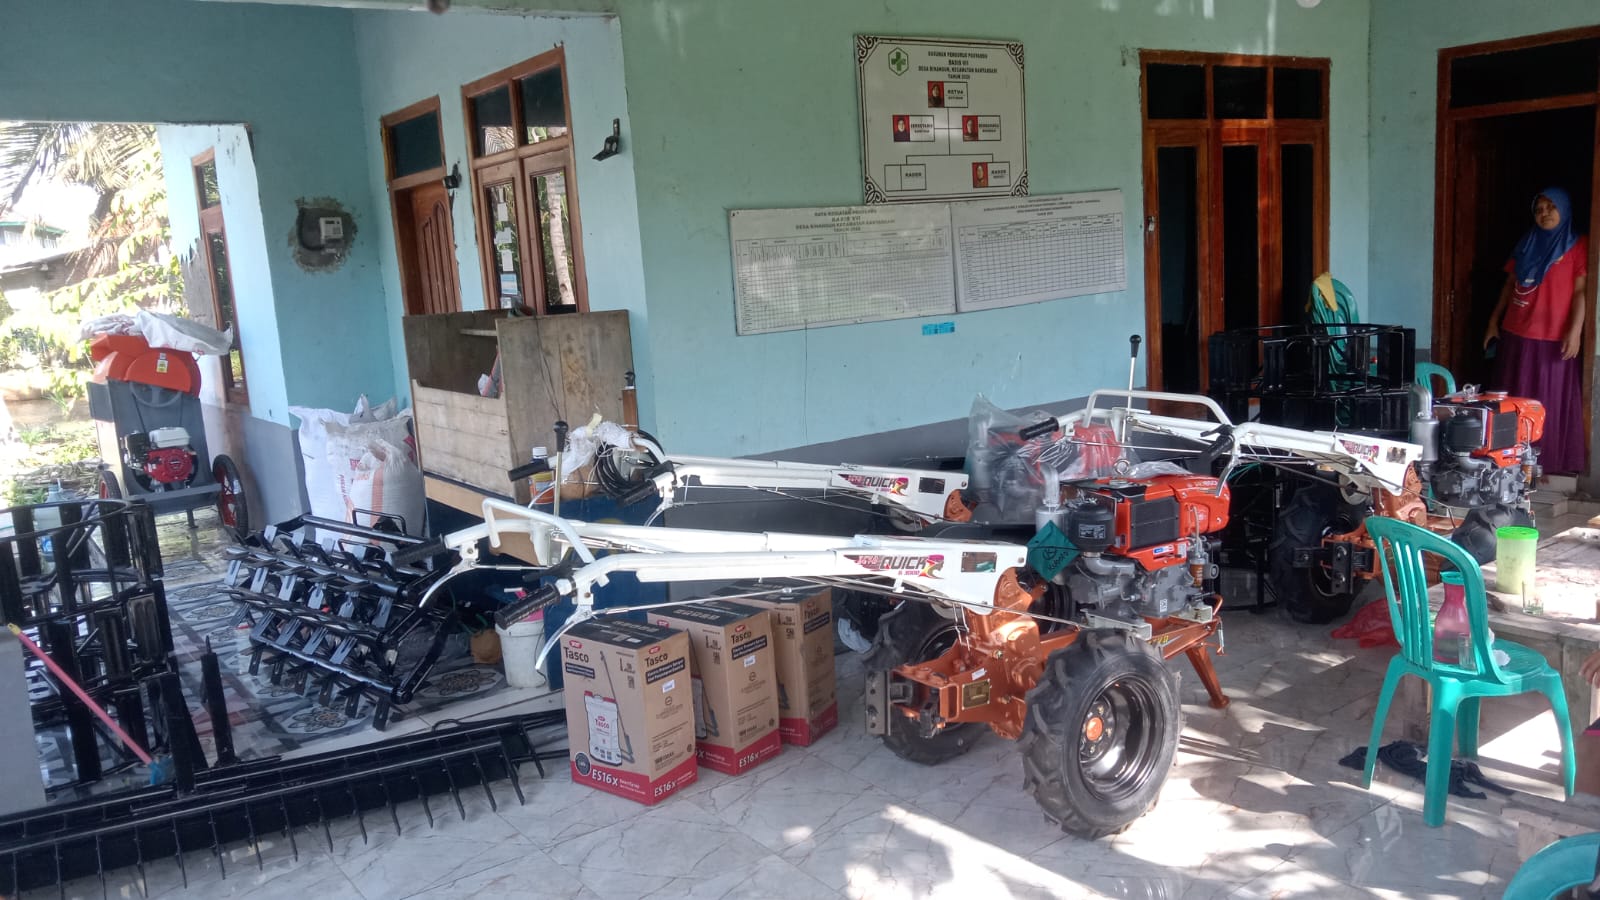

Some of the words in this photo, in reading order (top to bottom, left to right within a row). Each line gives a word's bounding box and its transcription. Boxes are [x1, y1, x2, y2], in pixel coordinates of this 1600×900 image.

[864, 476, 897, 488] QUICK
[880, 556, 928, 570] QUICK
[731, 631, 752, 645] Tasco
[563, 646, 589, 663] Tasco
[644, 652, 668, 667] Tasco
[595, 718, 609, 729] Tasco
[739, 751, 760, 768] ES16x
[592, 769, 618, 786] ES16x
[654, 780, 677, 797] ES16x
